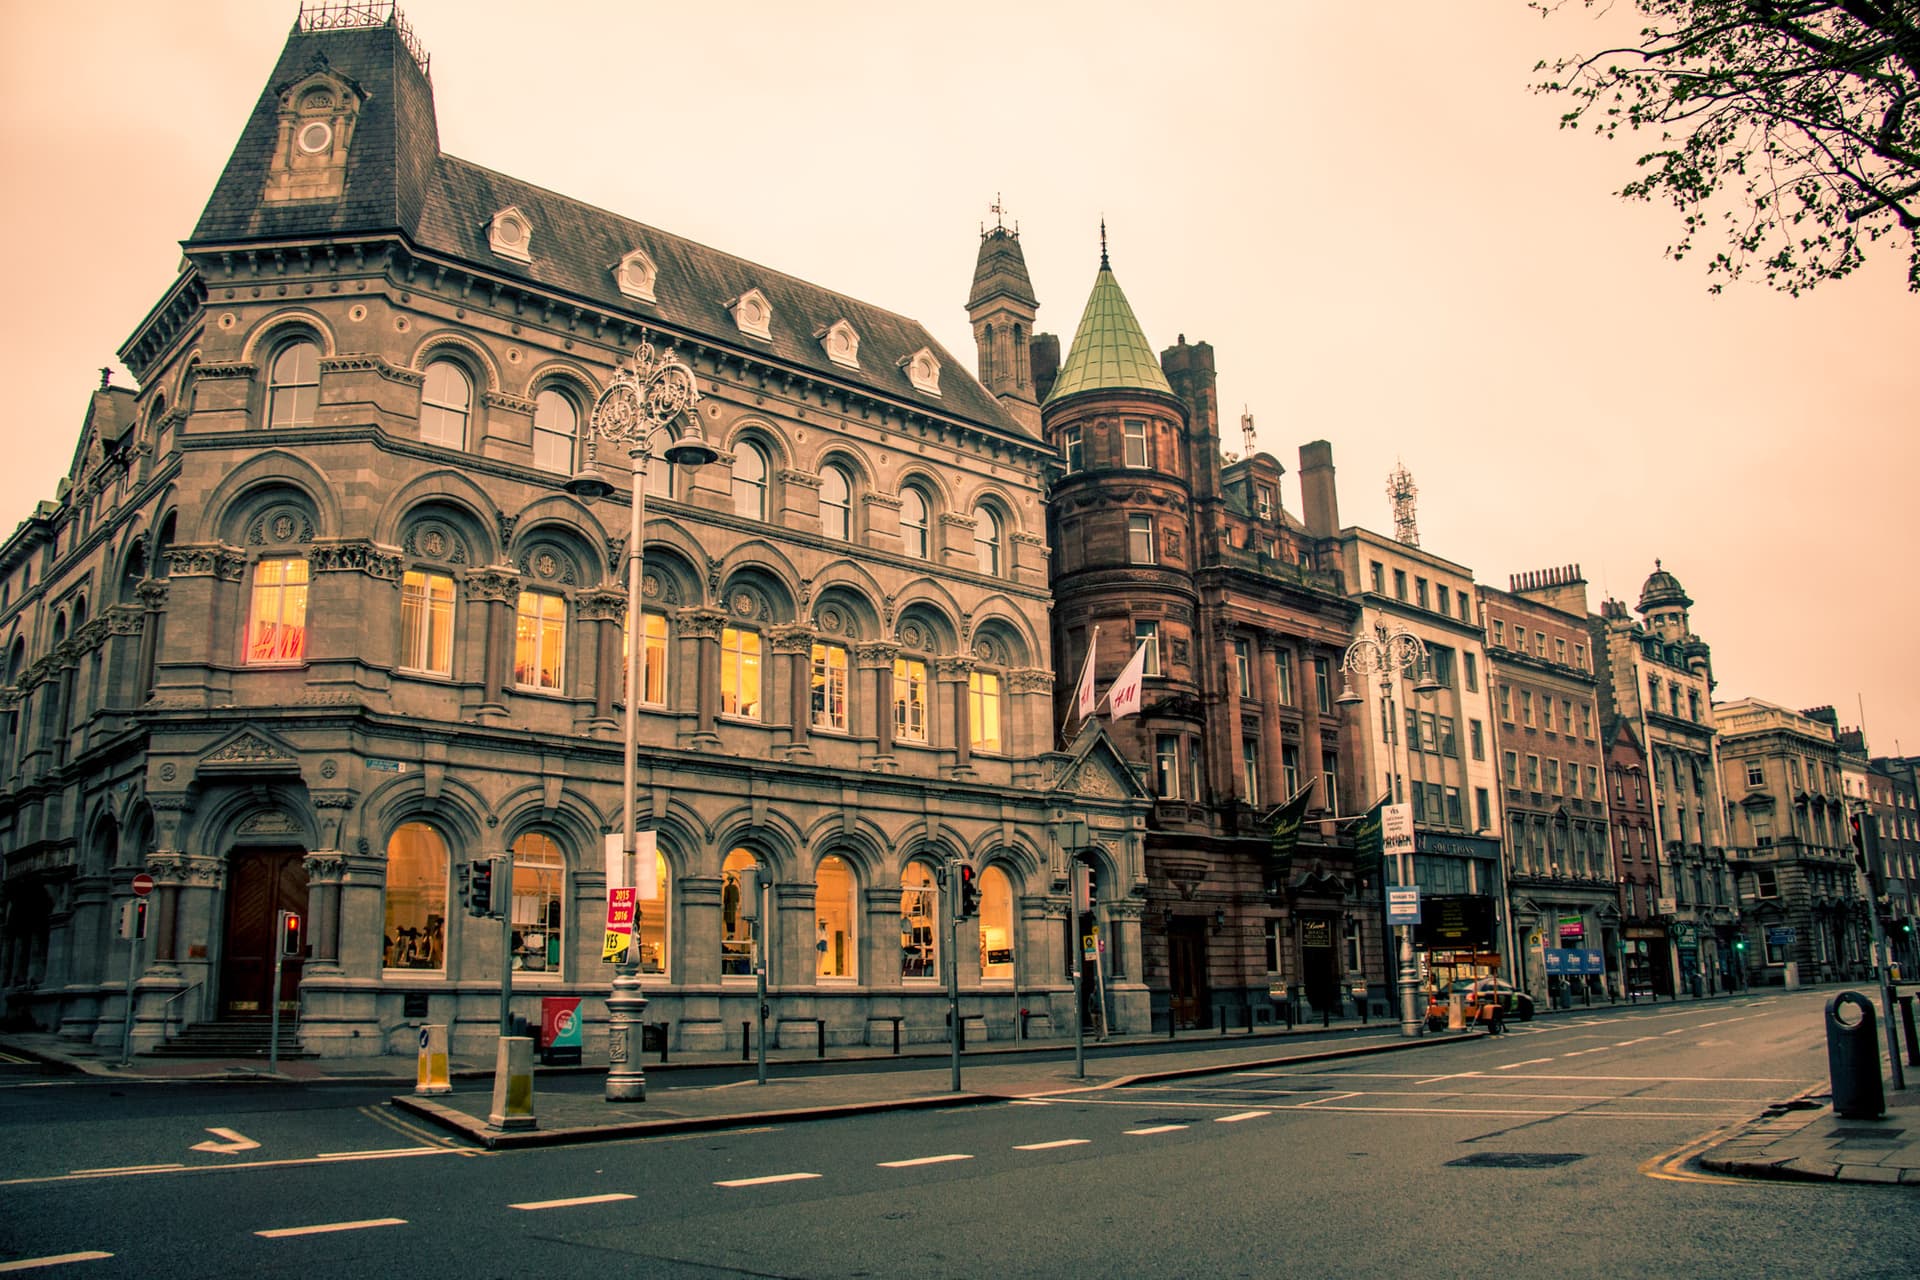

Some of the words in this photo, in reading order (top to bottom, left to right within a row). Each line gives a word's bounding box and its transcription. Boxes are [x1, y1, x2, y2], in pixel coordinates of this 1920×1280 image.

[616, 890, 630, 900] 2015
[614, 911, 628, 921] 2016
[606, 933, 618, 949] YES
